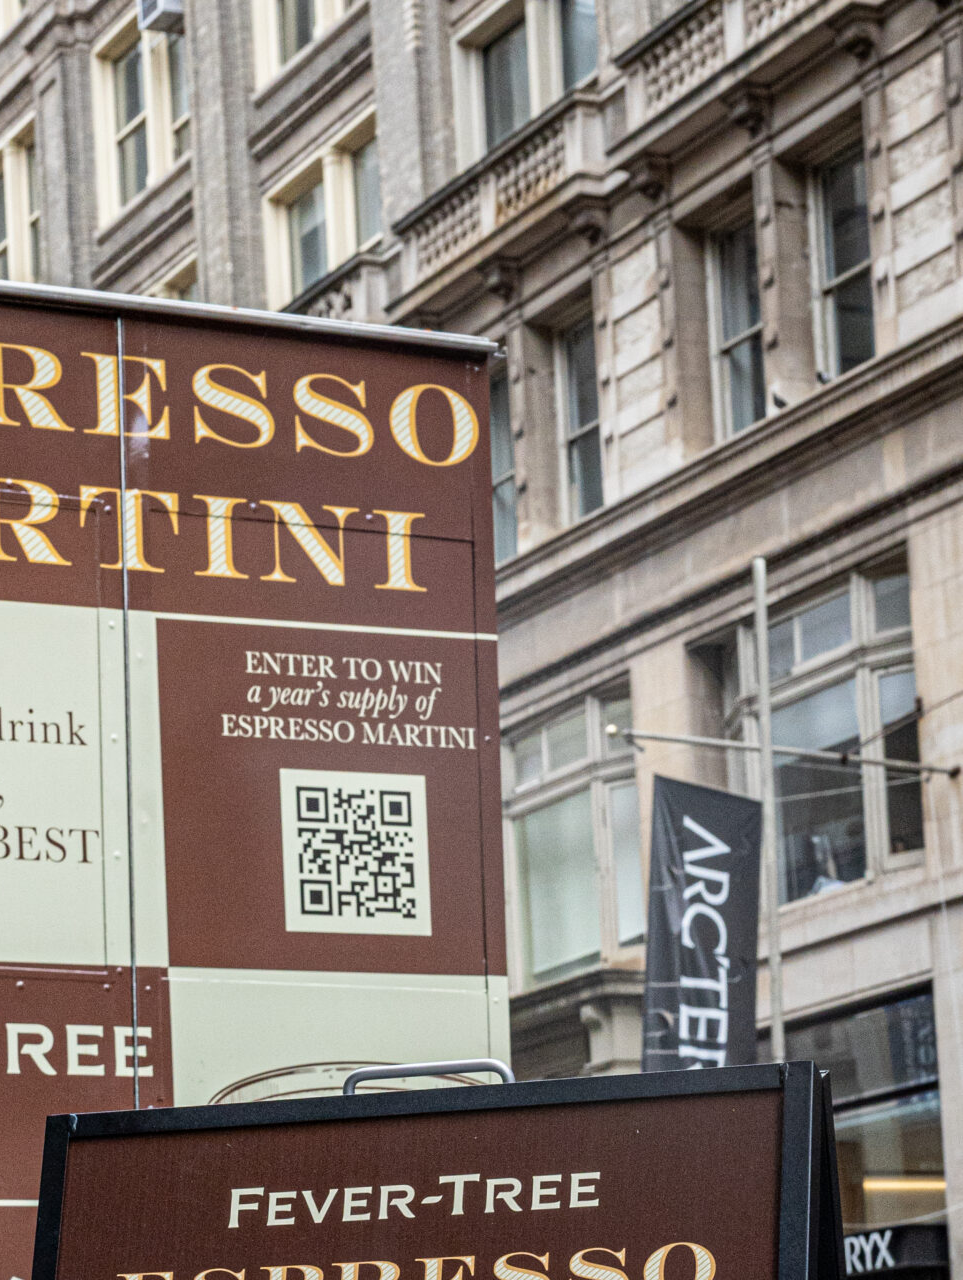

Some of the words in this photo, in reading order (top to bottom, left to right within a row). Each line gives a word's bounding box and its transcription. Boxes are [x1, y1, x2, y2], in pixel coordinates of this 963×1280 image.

[245, 651, 338, 679] ENTER
[342, 656, 383, 681] TO
[388, 660, 443, 685] WIN
[247, 685, 262, 703] a
[337, 685, 409, 719] supply
[415, 688, 443, 721] of
[221, 713, 356, 743] ESPRESSO
[361, 721, 477, 750] MARTINI
[227, 1171, 602, 1229] FEVER-TREE
